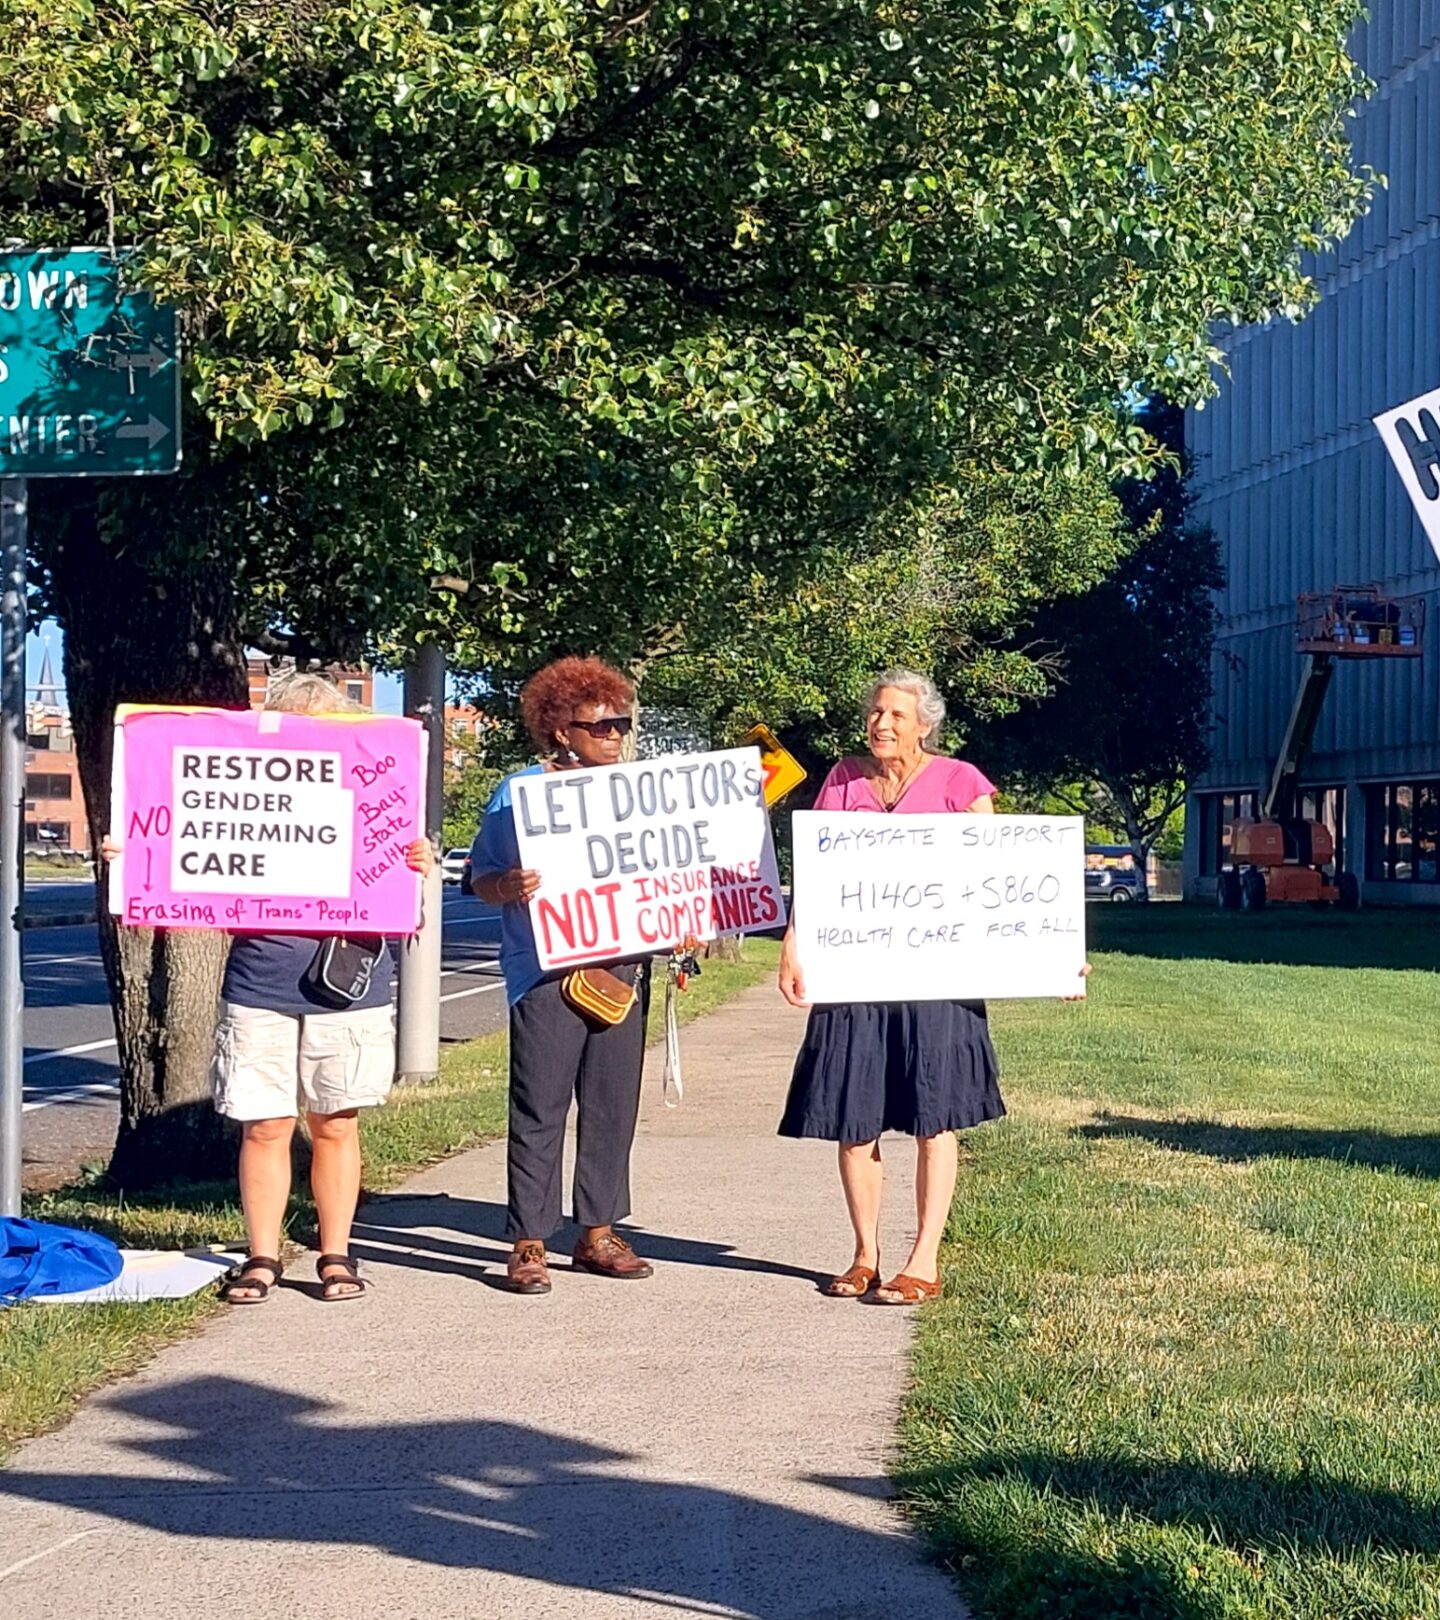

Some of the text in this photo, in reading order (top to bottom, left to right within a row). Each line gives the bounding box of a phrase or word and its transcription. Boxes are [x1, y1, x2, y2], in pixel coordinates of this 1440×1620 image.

[0, 414, 98, 454] NTER
[182, 754, 335, 783] RESTORE
[351, 755, 396, 788] Boo
[182, 790, 292, 812] GENDER
[518, 776, 593, 837] LET
[128, 805, 171, 840] NO
[180, 821, 338, 844] AFFIRMING
[586, 820, 716, 879] DECIDE
[818, 825, 1077, 853] BAYSTATE SUPPORT
[180, 852, 266, 877] CARE
[355, 842, 410, 887] Health
[128, 897, 215, 924] Erasing
[226, 900, 247, 919] of
[316, 900, 369, 925] People
[537, 860, 762, 955] NOT INSURANCE
[841, 881, 944, 912] H1405
[637, 885, 779, 944] COMPANIES
[907, 923, 966, 948] CARE
[987, 921, 1028, 937] FOR
[1041, 917, 1079, 935] ALL
